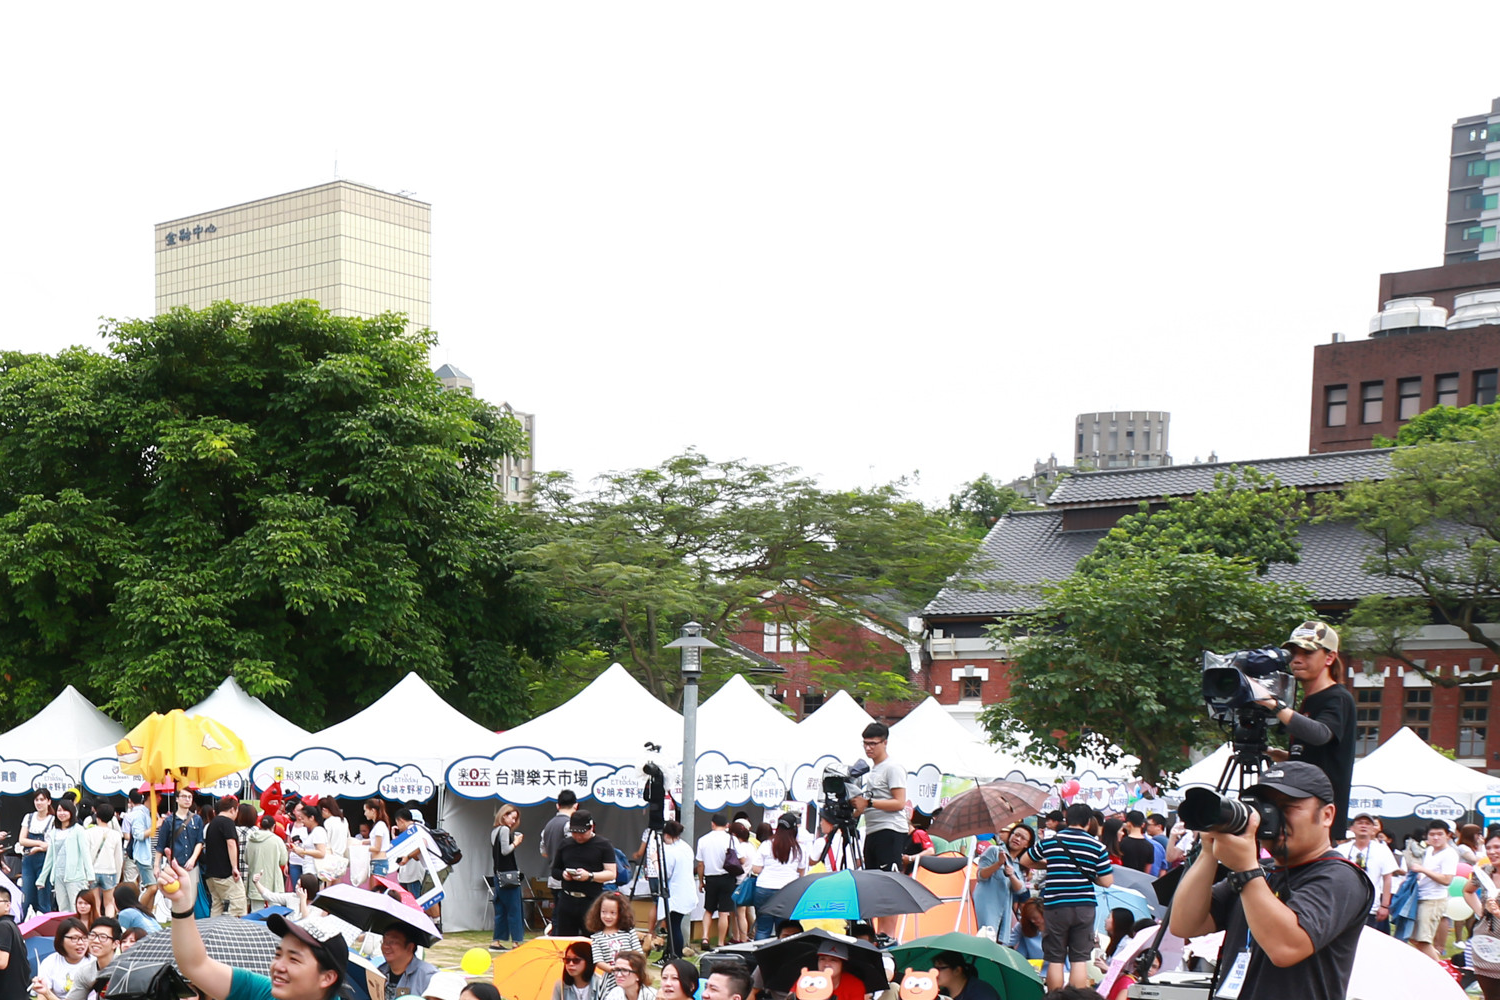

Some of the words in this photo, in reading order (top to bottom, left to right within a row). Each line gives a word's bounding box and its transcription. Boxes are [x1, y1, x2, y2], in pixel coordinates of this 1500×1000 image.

[165, 223, 217, 246] 金融中心
[496, 769, 588, 787] 台灣樂天市場
[697, 773, 749, 791] 台灣樂天市場
[382, 784, 431, 795] 好朋友野餐日
